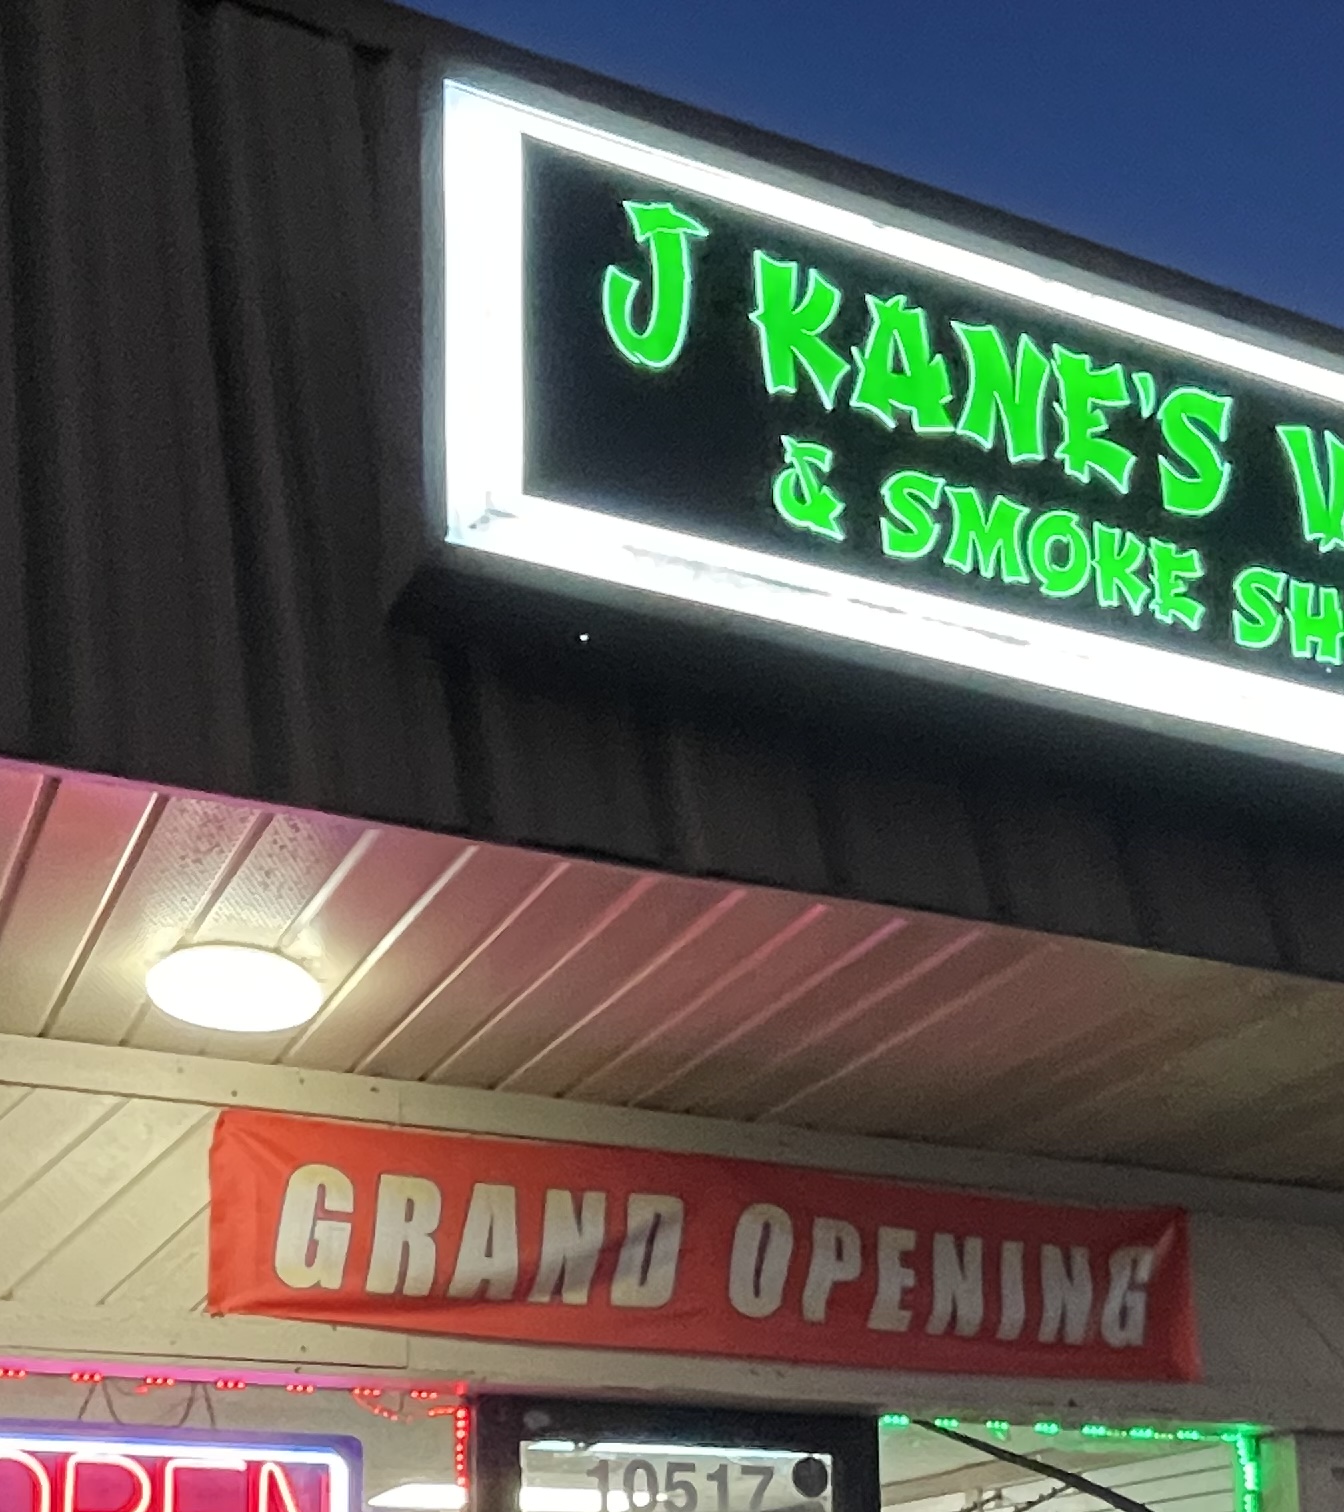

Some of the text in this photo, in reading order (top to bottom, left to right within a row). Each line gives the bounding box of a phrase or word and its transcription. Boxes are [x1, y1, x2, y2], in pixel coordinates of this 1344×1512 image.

[602, 200, 709, 368] J
[750, 248, 1233, 517] KANE'S
[773, 433, 846, 541] &
[880, 470, 1205, 631] SMOKE
[274, 1163, 1154, 1348] GRAND OPENING
